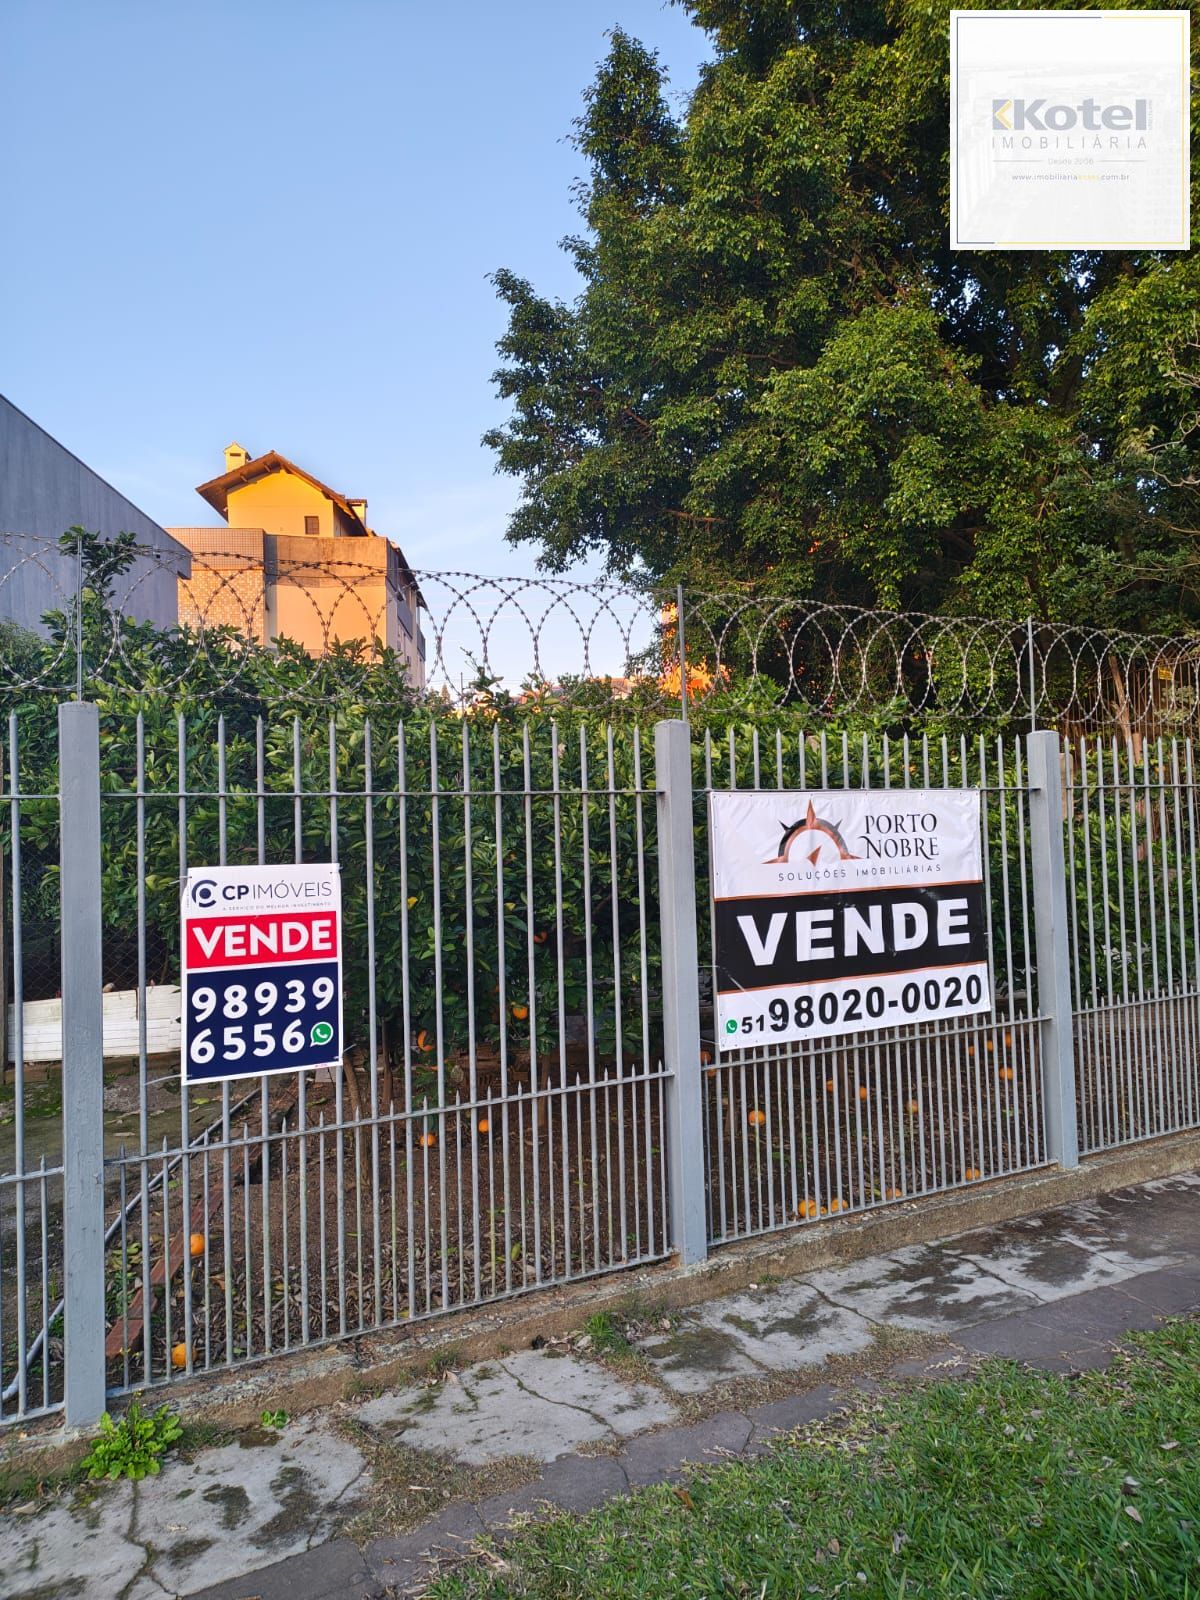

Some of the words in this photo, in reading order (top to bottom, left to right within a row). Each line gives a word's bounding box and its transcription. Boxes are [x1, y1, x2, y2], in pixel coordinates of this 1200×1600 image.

[864, 813, 938, 835] PORTO
[857, 836, 940, 861] NOBRE
[778, 869, 847, 882] SOLUÇÕES
[856, 864, 942, 877] IMOBILIÁRIAS
[192, 919, 332, 960] VENDE
[736, 897, 971, 967] VENDE
[191, 976, 335, 1023] 98939
[741, 1013, 765, 1034] 51
[768, 974, 982, 1032] 98020-0020
[190, 1018, 306, 1064] 6556
